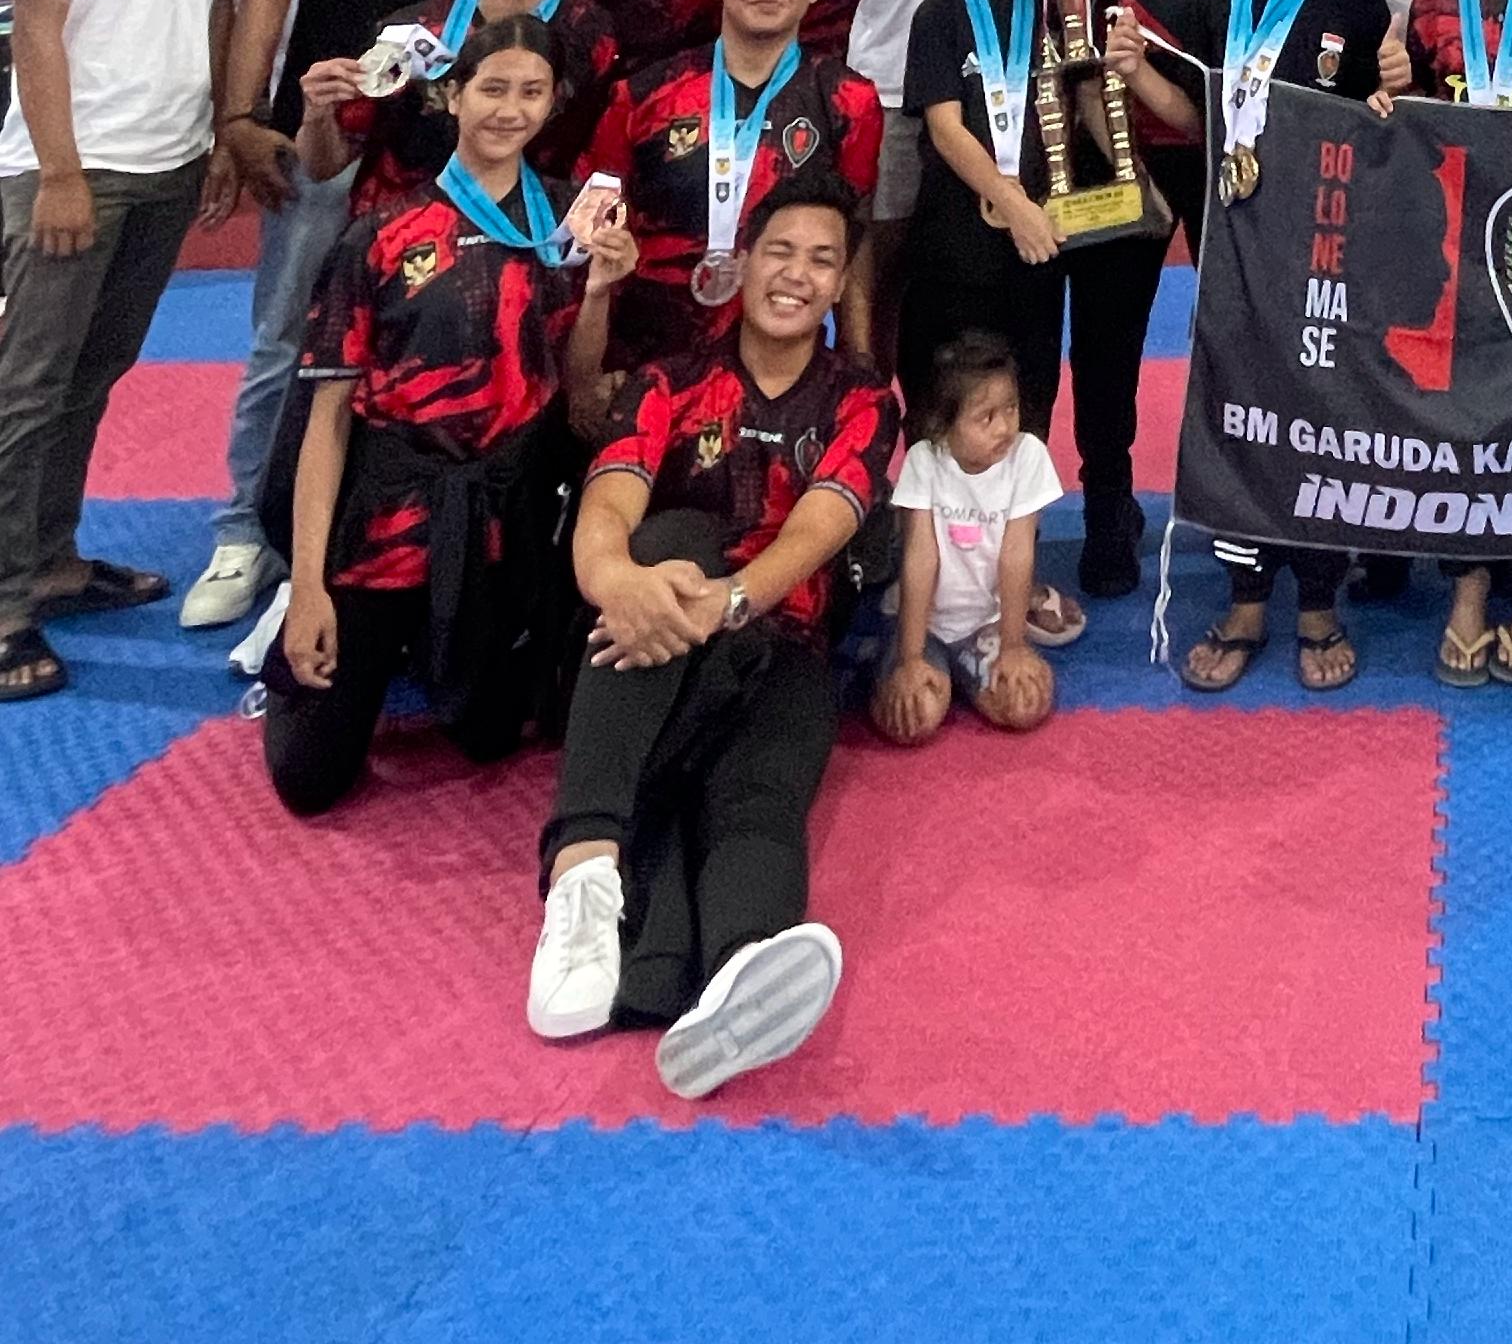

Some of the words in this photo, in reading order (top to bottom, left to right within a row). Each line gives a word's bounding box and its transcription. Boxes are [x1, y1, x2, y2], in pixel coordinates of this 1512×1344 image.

[1320, 141, 1354, 183] BO
[1315, 185, 1347, 225] LO
[1309, 232, 1346, 276] NE
[1304, 277, 1348, 323] MA
[1299, 325, 1338, 369] SE
[1223, 403, 1279, 446] BM
[1289, 417, 1461, 476] GARUDA
